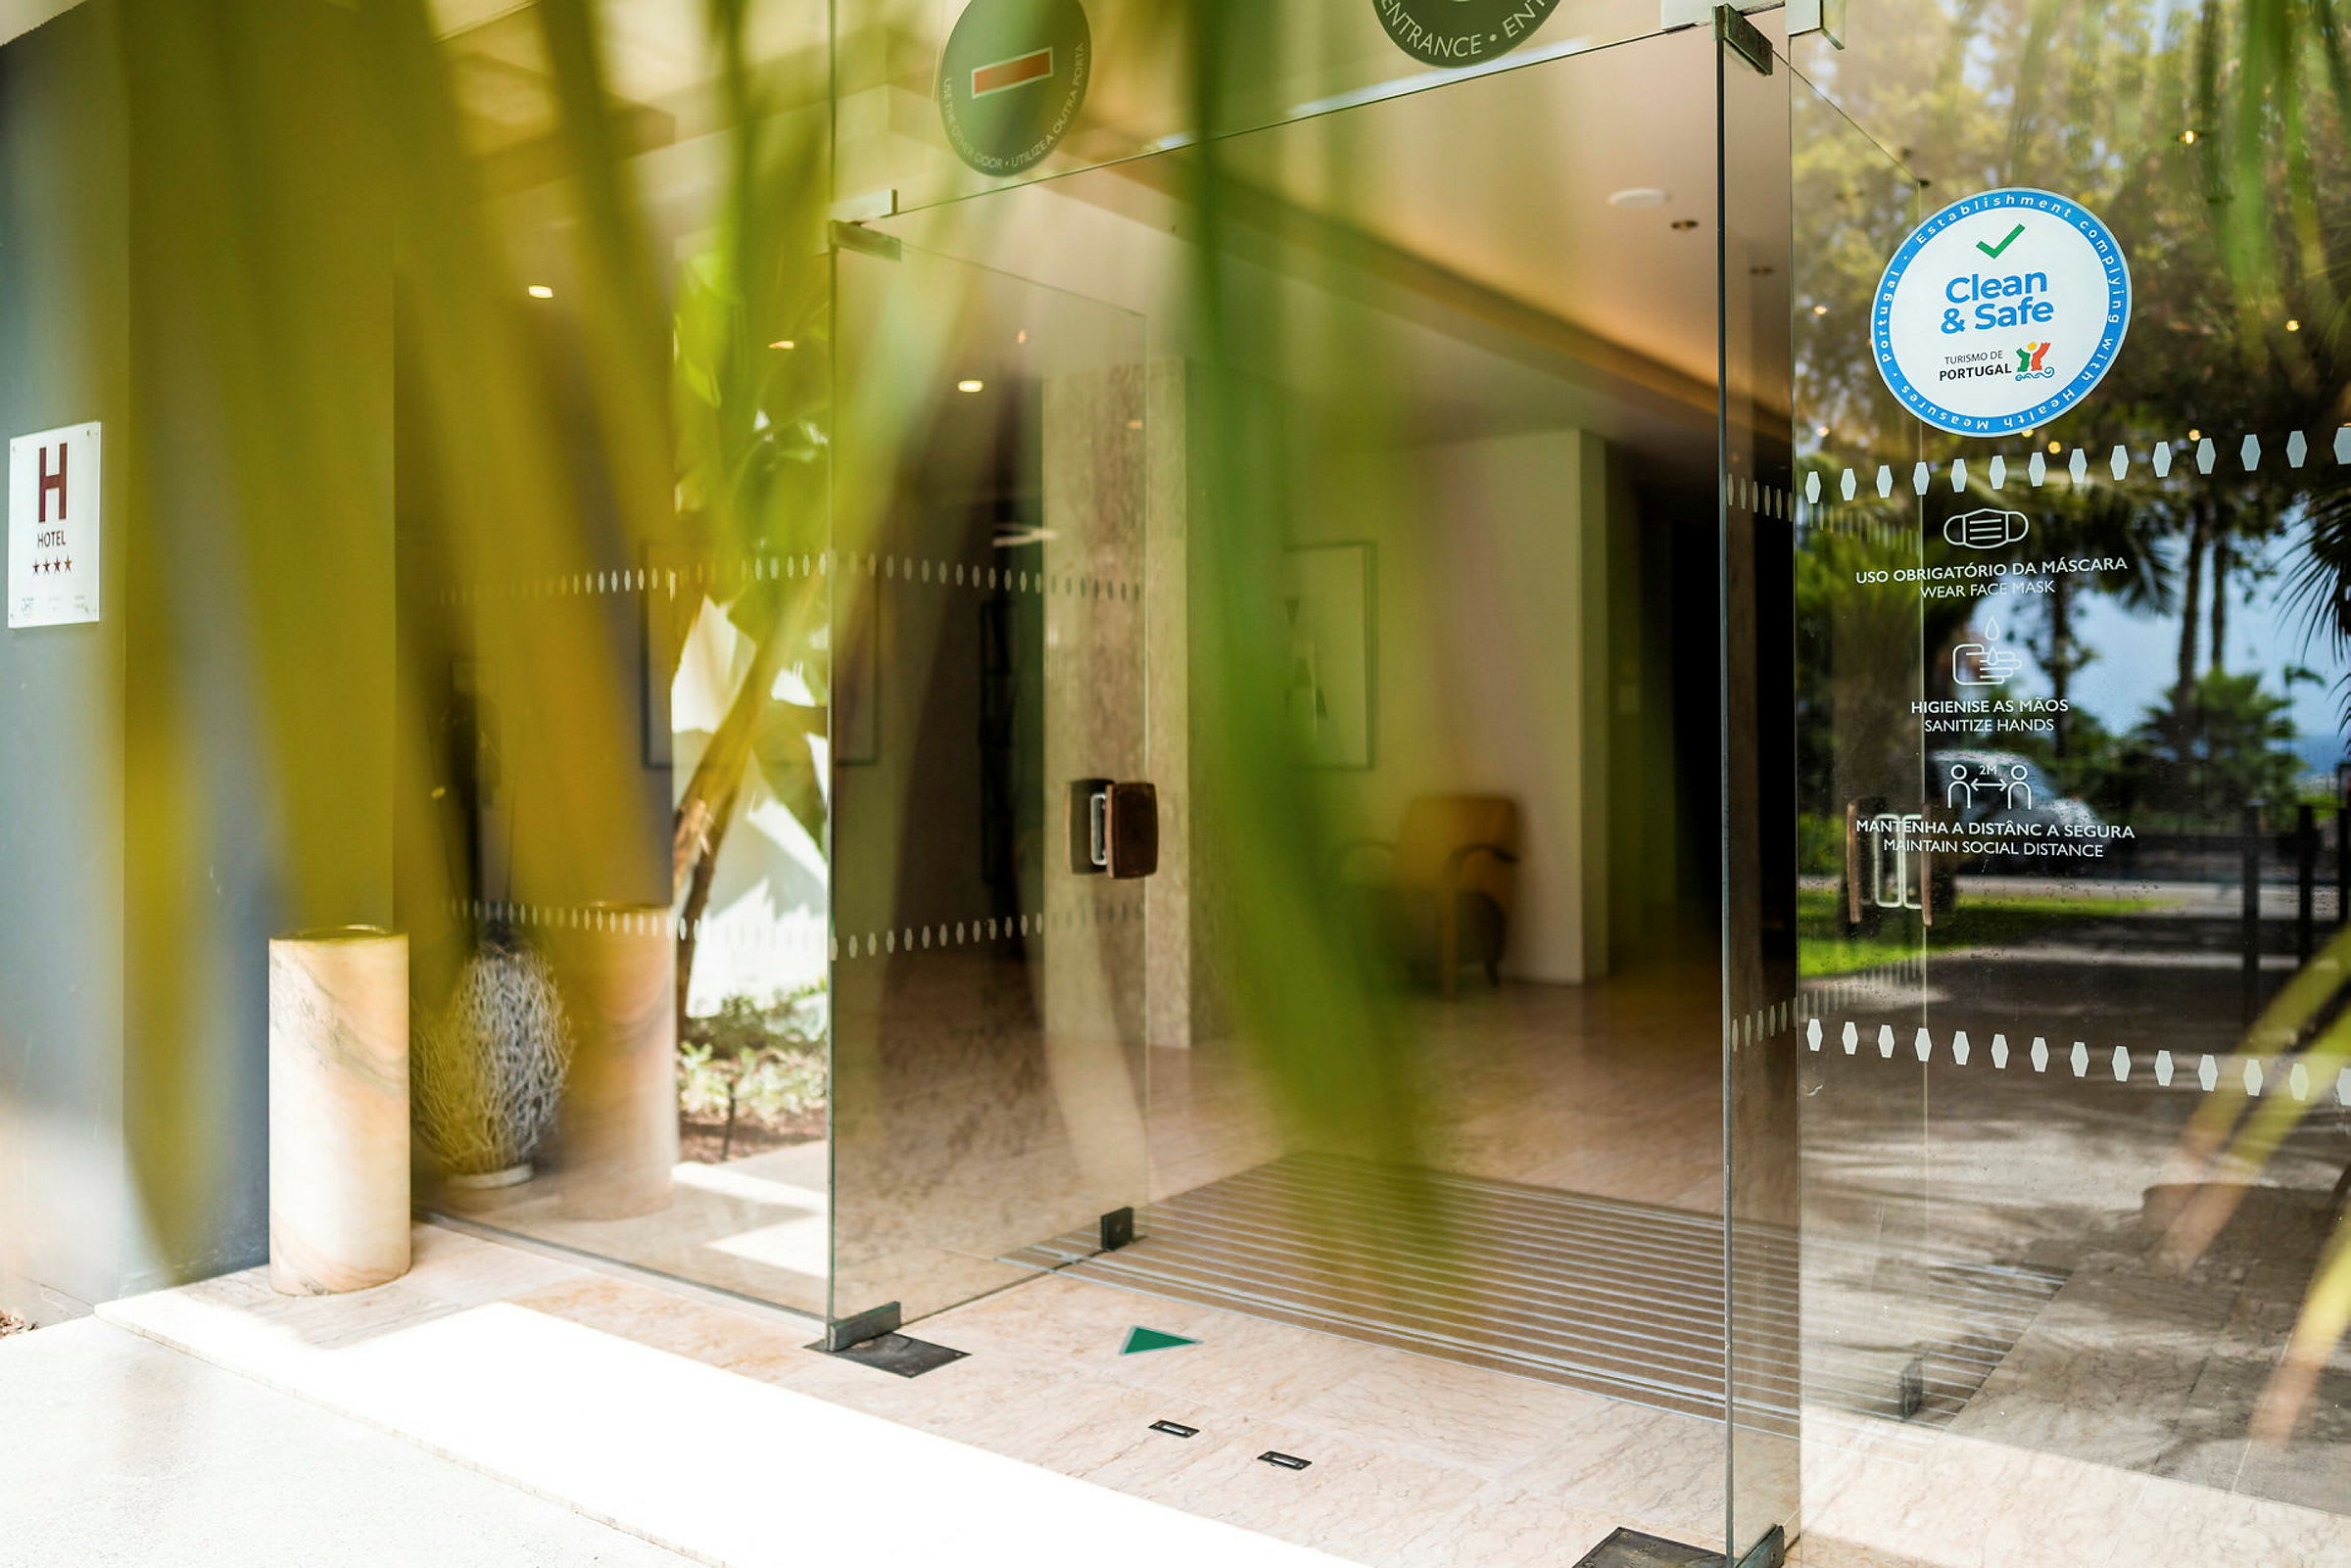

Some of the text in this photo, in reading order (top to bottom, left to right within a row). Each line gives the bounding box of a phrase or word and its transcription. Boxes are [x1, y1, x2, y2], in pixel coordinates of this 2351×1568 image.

[1945, 271, 2047, 304] Clean
[1879, 194, 2123, 430] Establishment complying with Health Measures Portugal
[1941, 296, 2054, 334] & Safe
[1944, 350, 2004, 364] TURISMO DE
[1940, 363, 2012, 381] PORTUGAL
[39, 443, 68, 523] H
[37, 530, 67, 548] HOTEL
[1856, 557, 2128, 584] USO OBRIGATÓRIO DA MÁSCARA
[1920, 580, 2056, 599] WEAR FACE MASK
[1911, 696, 2069, 714] HIGIENISE AS MÃOS
[1924, 718, 2054, 733] SANITIZE HANDS
[1979, 765, 1997, 775] 2M
[1856, 820, 1948, 834] MANTENHA
[1950, 821, 1964, 834] A
[2063, 824, 2135, 839] SEGURA
[1884, 838, 2104, 858] MAINTAIN SOCIAL DISTANCE
